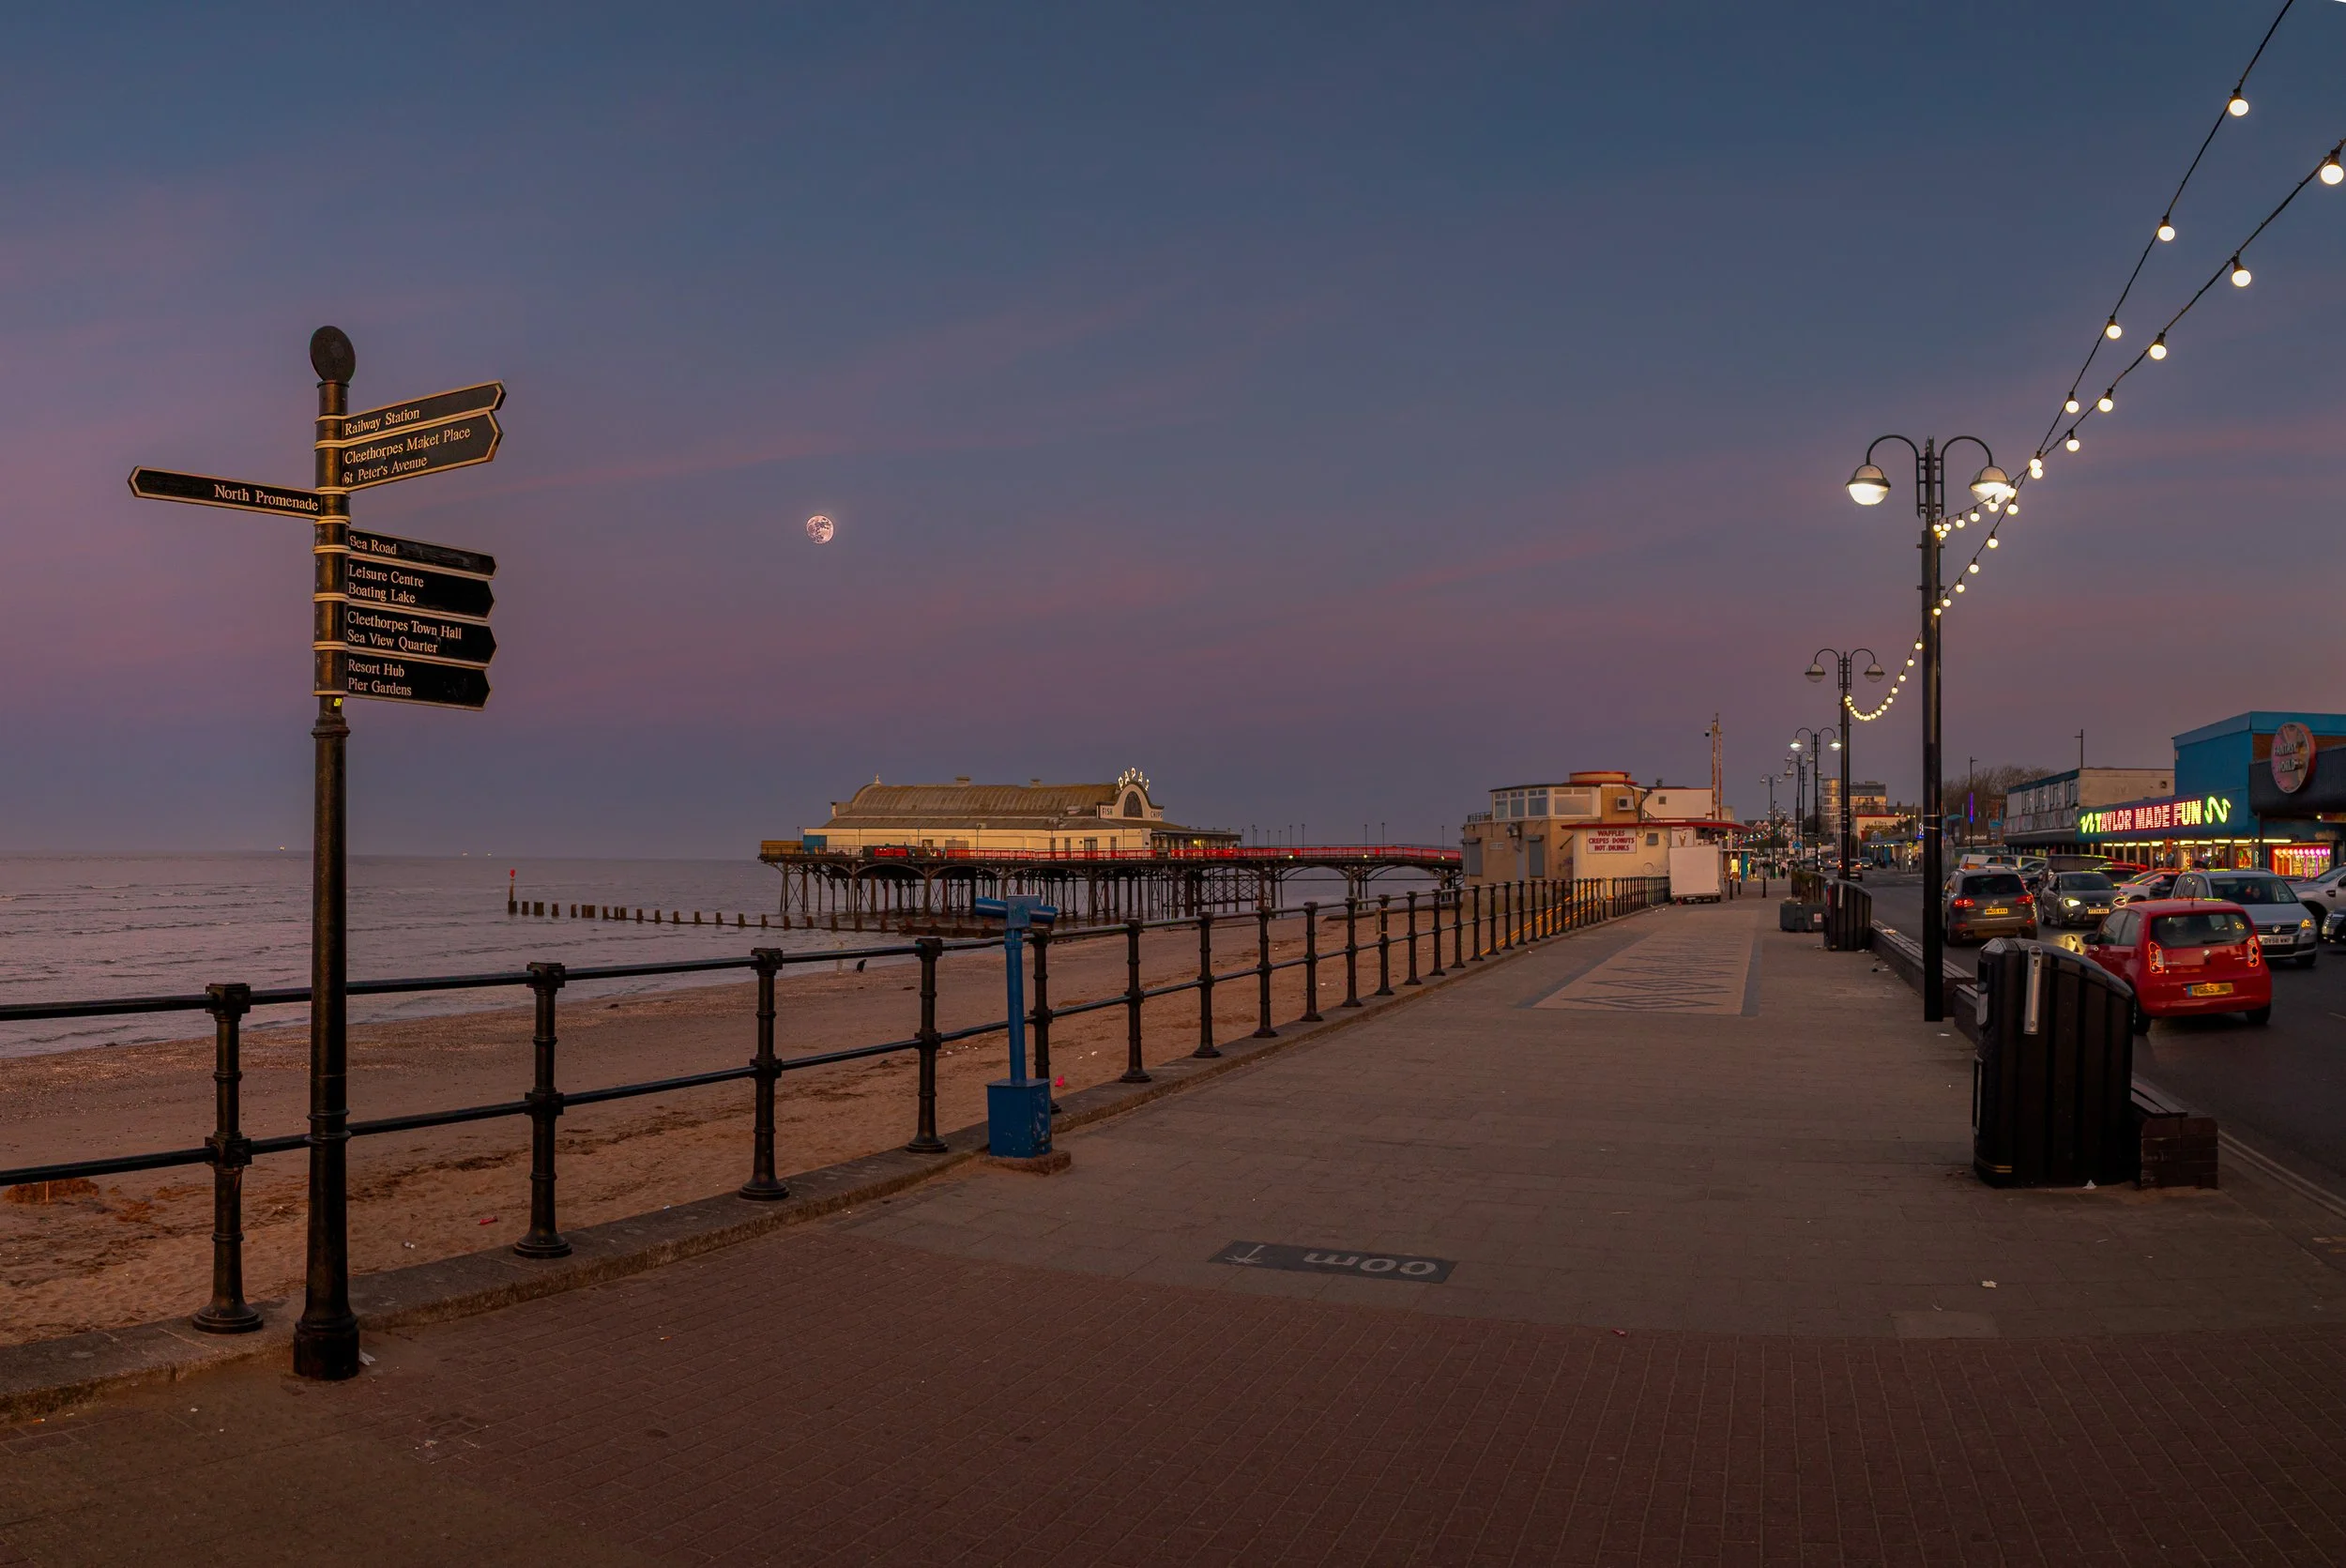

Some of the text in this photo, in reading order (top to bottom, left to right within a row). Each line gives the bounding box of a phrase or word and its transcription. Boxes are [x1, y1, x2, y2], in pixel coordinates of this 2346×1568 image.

[344, 407, 420, 436] Railway Station
[344, 441, 404, 465] Cleethorpes
[444, 426, 471, 442] Place
[343, 455, 428, 486] St Peter's Avenue
[214, 483, 319, 512] North Promenade
[349, 535, 397, 556] Sea Road
[348, 565, 424, 587] Leisure Centre
[348, 582, 416, 603] Boating Lake
[347, 612, 463, 640] Cleethorpes Town Hall
[347, 630, 438, 653] Sea View Quarter
[348, 658, 405, 677] Resort Hub
[348, 677, 412, 696] Pier Gardens
[1102, 807, 1163, 819] FISH CHIPS
[2095, 800, 2202, 833] TAYLOR MADE FUN
